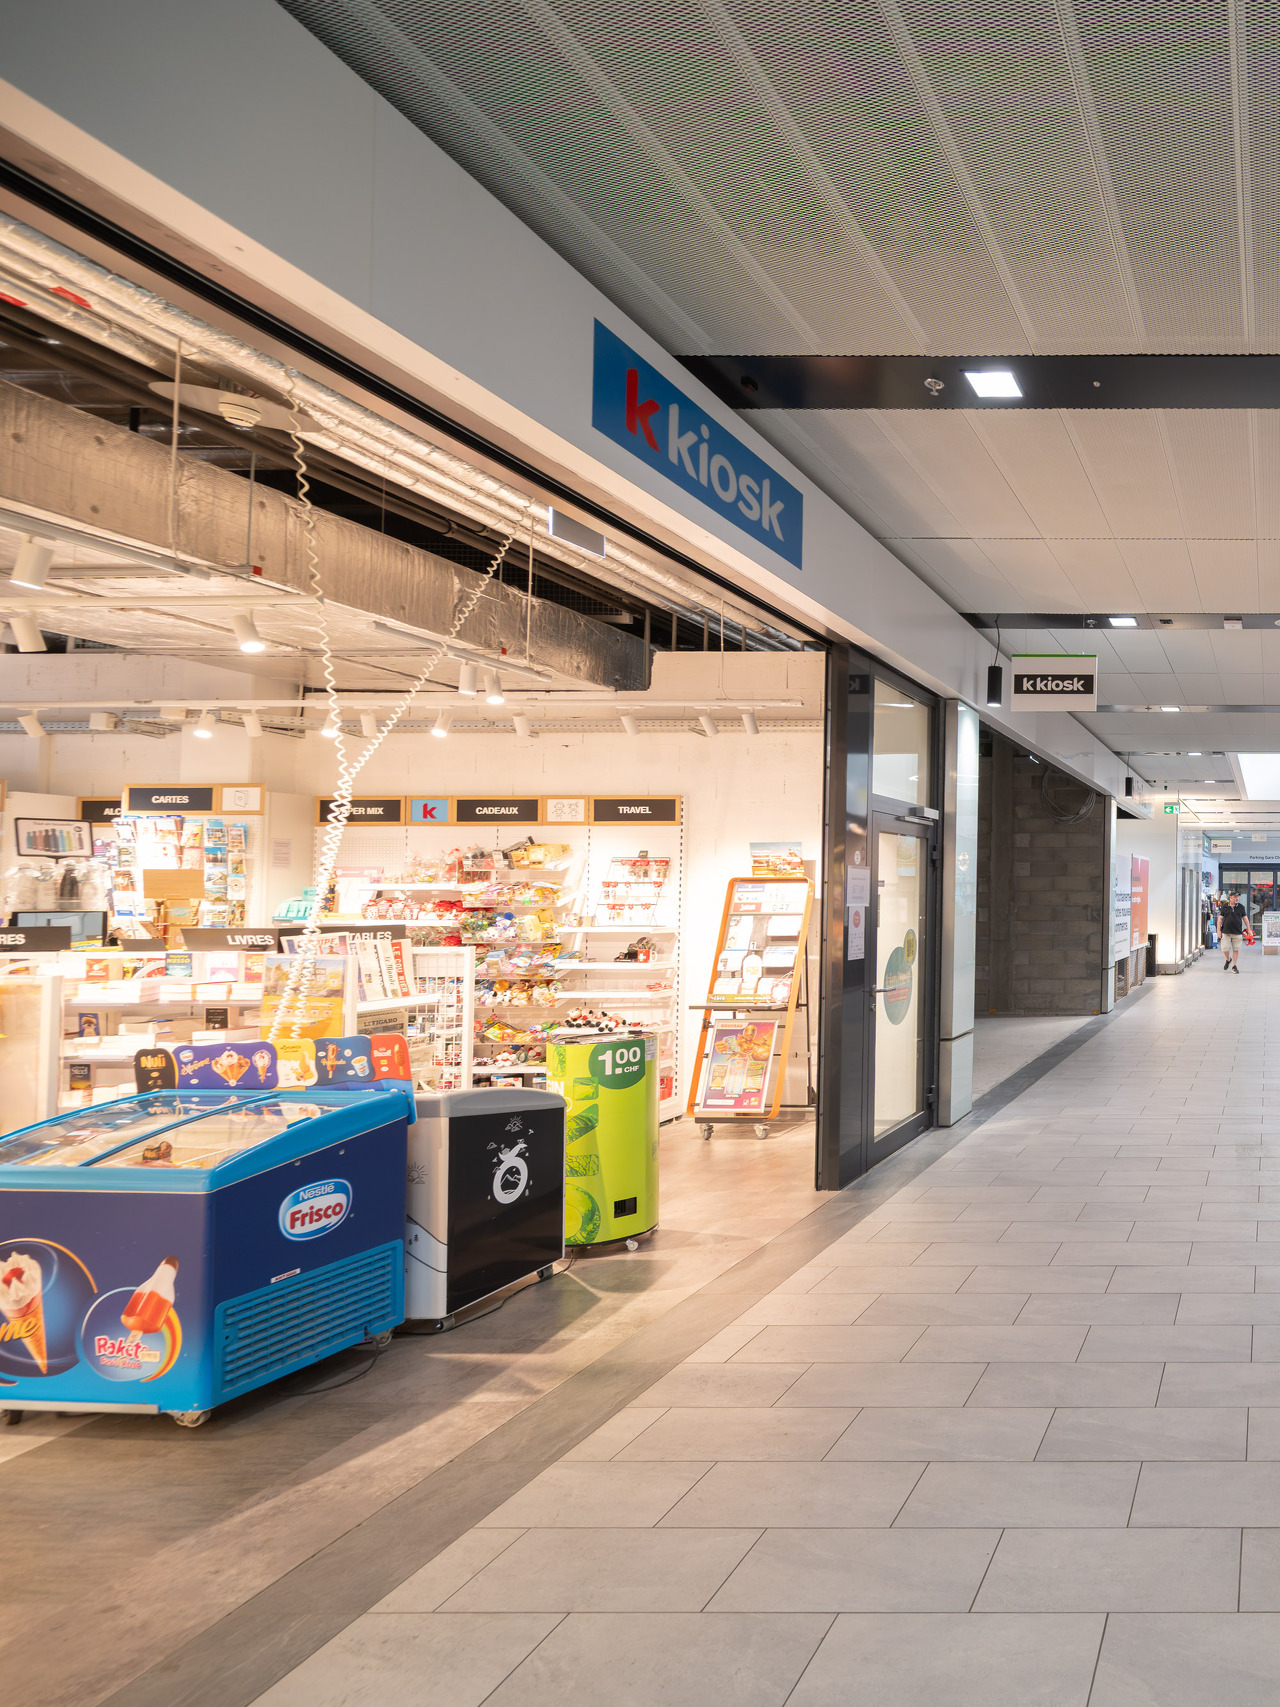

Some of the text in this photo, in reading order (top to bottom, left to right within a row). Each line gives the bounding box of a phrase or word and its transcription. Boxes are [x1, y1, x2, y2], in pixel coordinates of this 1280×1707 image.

[625, 368, 785, 543] k kiosk
[1022, 676, 1085, 691] k kiosk
[151, 795, 190, 804] CARTES
[366, 807, 384, 815] MIX
[475, 806, 519, 815] CADEAUX
[617, 806, 652, 814] TRAVEL
[226, 934, 275, 945] LIVRES
[371, 1018, 398, 1026] FIGARO
[624, 1065, 640, 1073] CHF
[299, 1182, 335, 1202] Nestlé
[289, 1201, 344, 1230] Frisco
